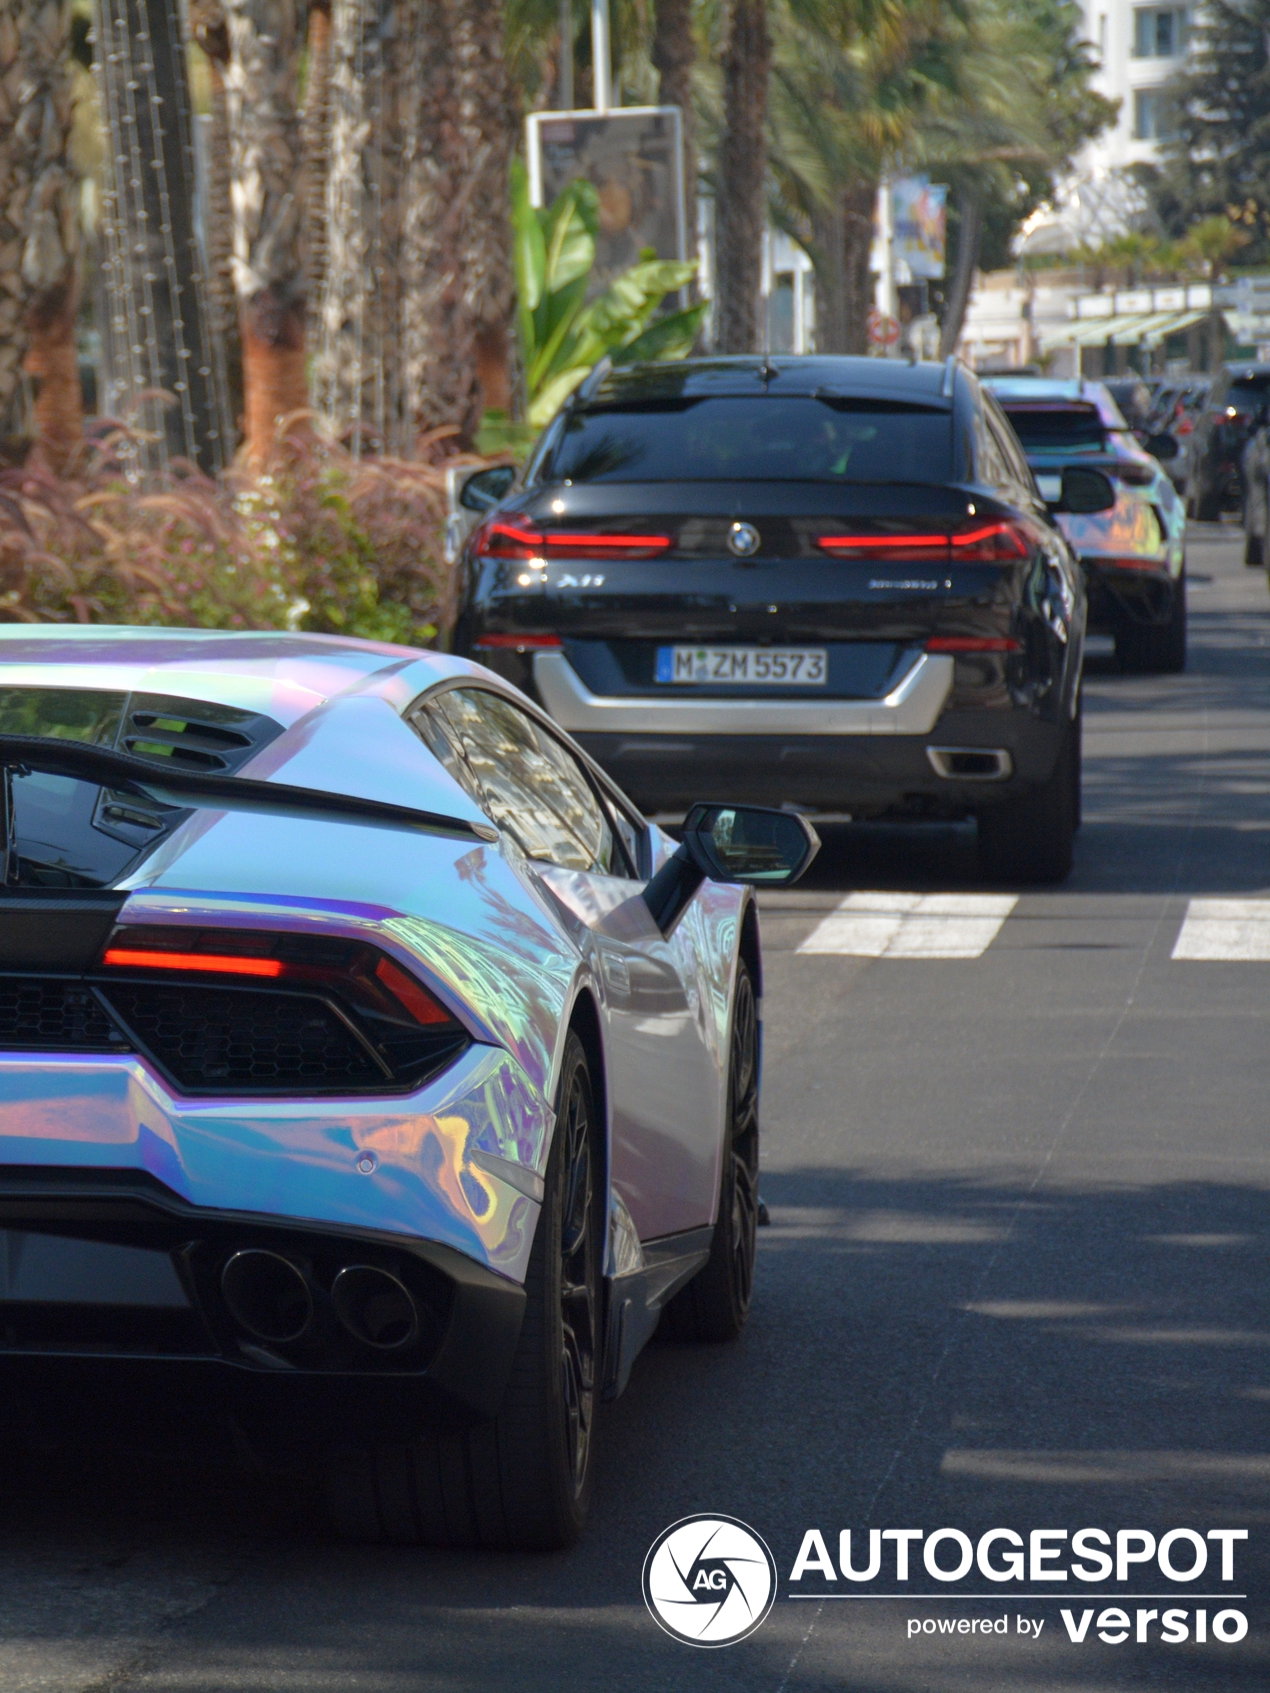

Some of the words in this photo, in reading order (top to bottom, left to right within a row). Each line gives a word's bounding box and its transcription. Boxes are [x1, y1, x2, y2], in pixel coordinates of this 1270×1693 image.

[675, 651, 693, 677] M
[712, 652, 749, 679] ZM
[754, 653, 824, 680] 5573
